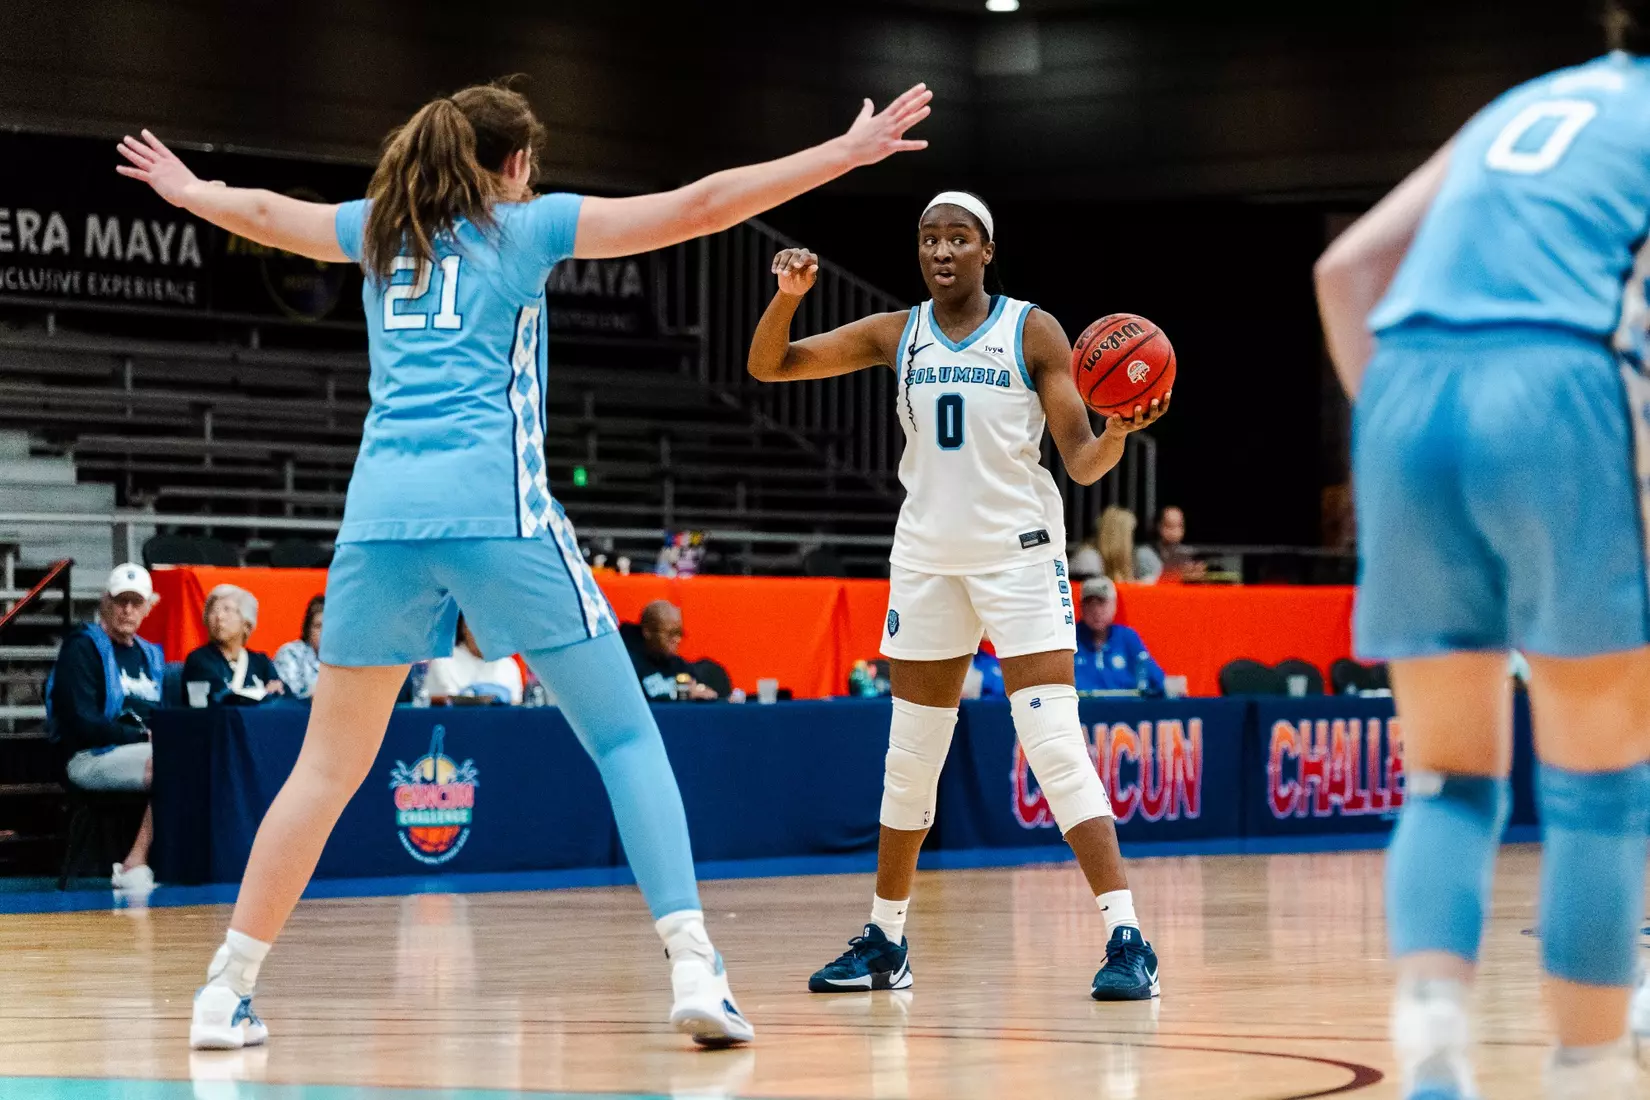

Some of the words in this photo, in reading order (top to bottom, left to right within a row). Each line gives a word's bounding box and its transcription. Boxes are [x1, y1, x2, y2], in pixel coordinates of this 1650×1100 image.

[1485, 100, 1597, 173] 0
[85, 213, 201, 267] MAYA
[0, 265, 81, 294] CLUSIVE
[87, 270, 196, 304] EXPERIENCE
[384, 254, 462, 331] 21
[1083, 322, 1145, 372] Wilson
[907, 366, 1011, 388] COLUMBIA
[935, 392, 965, 451] 0
[1011, 718, 1203, 828] CNCUN
